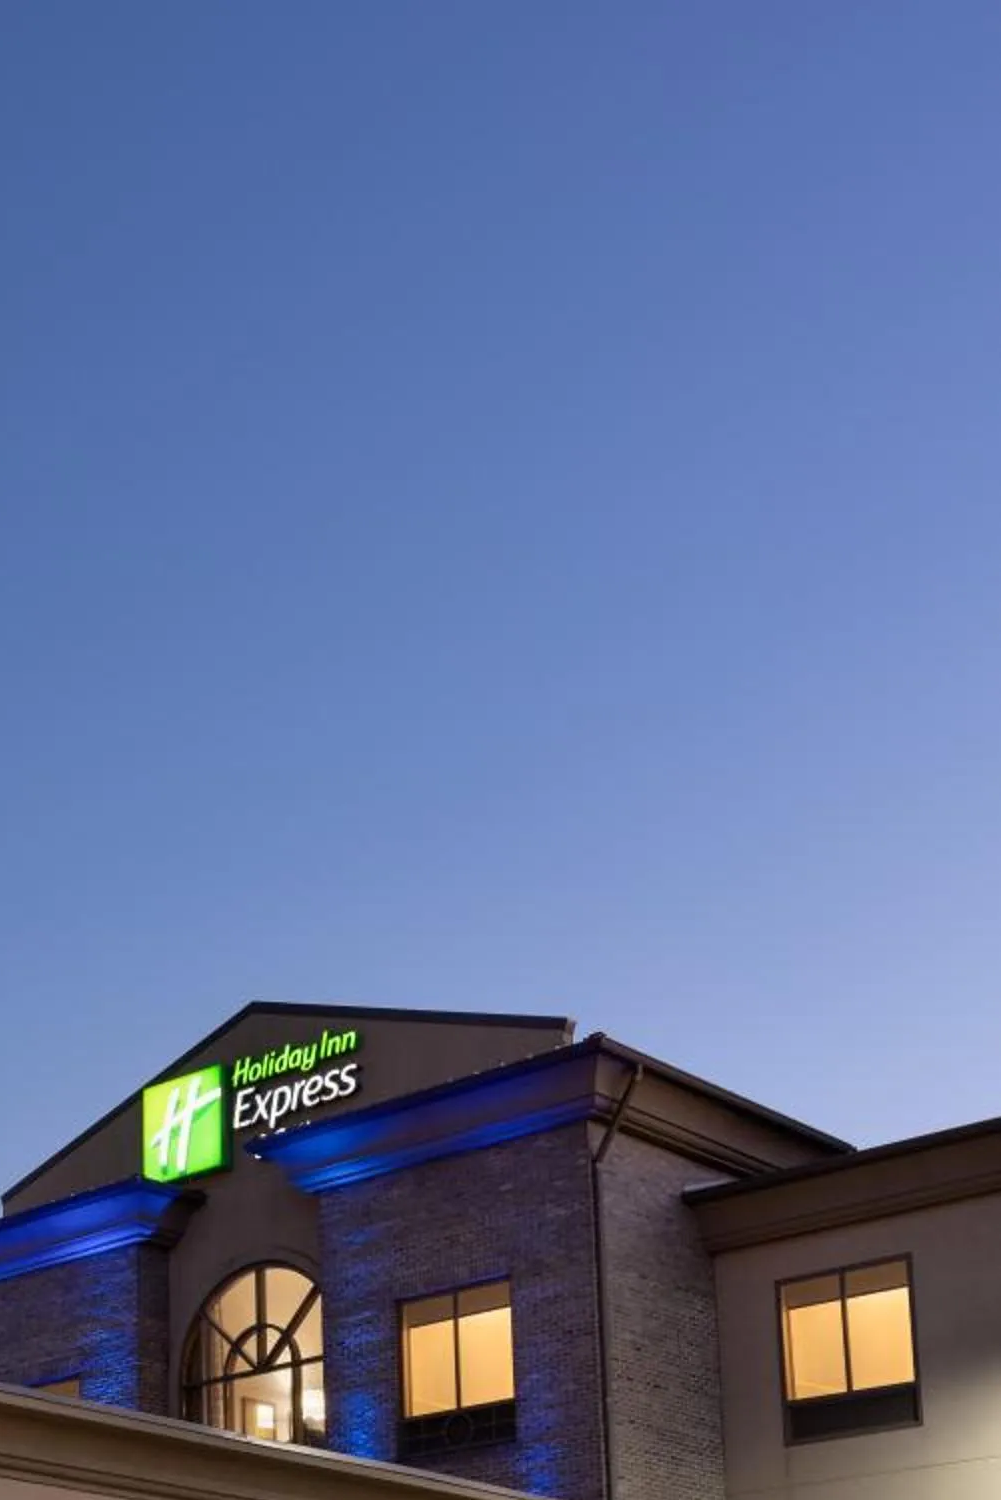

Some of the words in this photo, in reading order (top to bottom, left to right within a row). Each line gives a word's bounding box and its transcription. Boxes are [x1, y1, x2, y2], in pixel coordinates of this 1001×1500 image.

[232, 1043, 317, 1087] Holiday
[320, 1030, 357, 1059] Inn
[233, 1063, 358, 1129] Express
